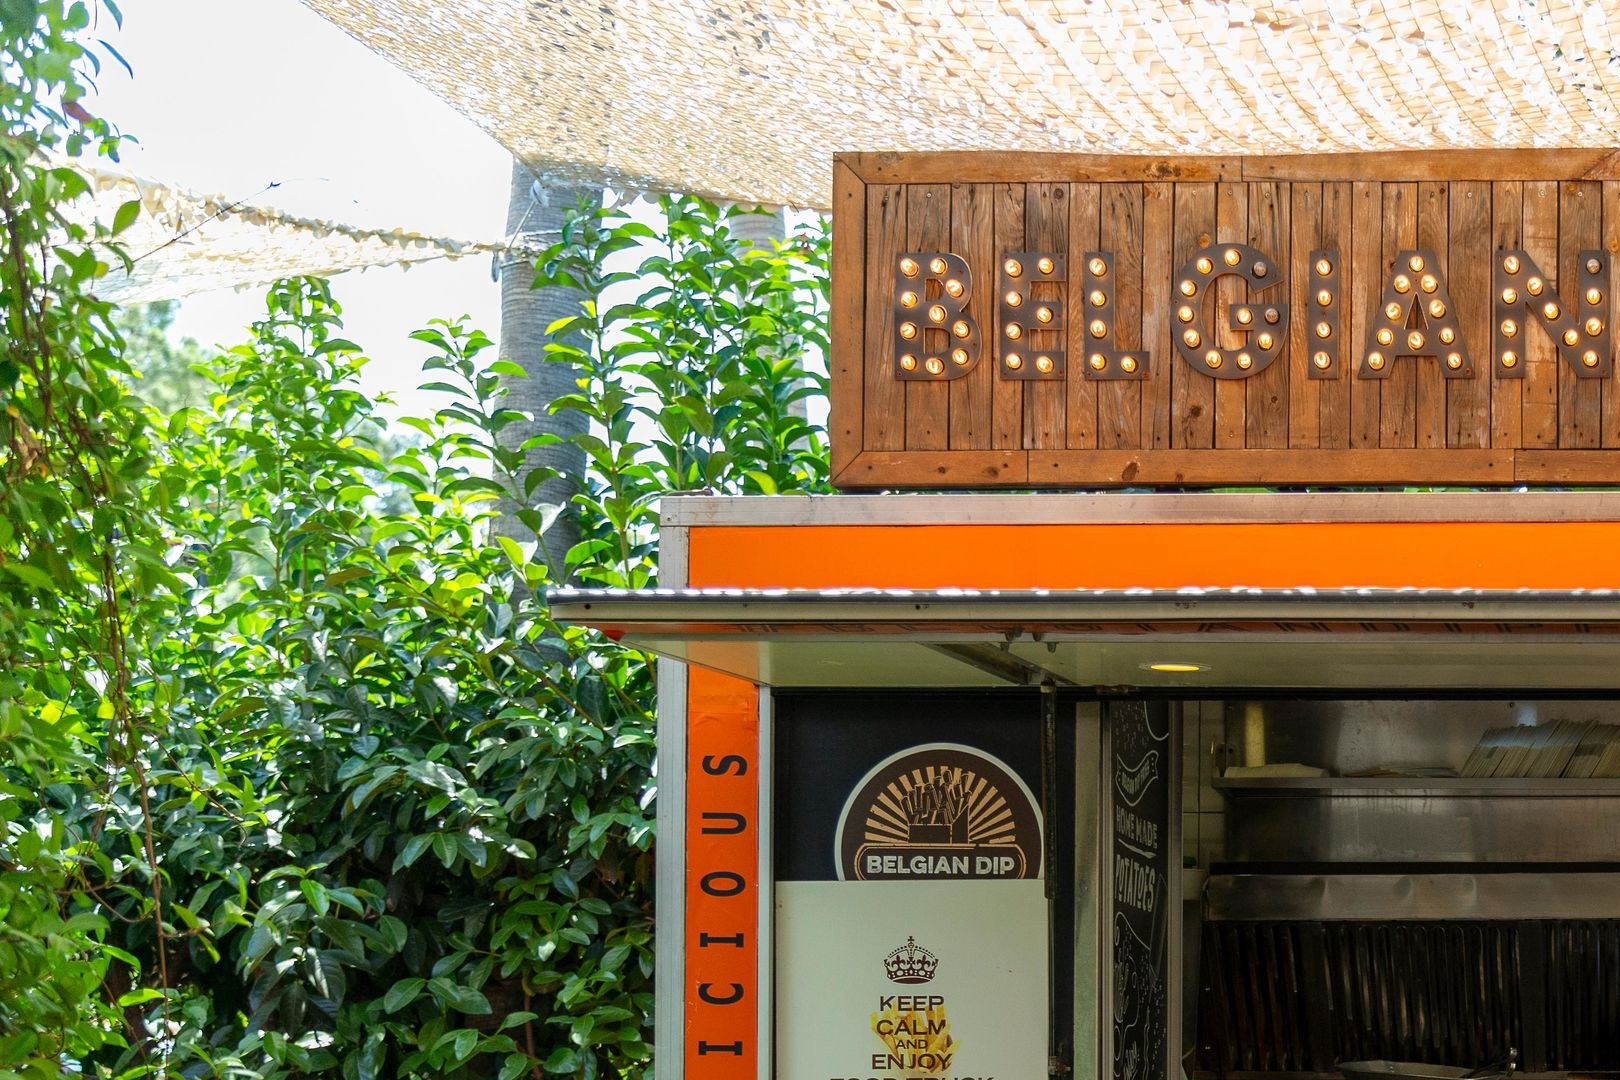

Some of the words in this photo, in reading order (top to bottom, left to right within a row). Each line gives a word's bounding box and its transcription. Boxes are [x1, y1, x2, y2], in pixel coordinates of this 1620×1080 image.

[894, 243, 1611, 380] BELGIAN
[1117, 804, 1135, 840] HOME
[1135, 815, 1158, 849] MADE
[866, 854, 970, 875] BELGIAN
[975, 855, 1015, 875] DIP
[1115, 854, 1156, 913] POTATOES
[879, 995, 945, 1012] KEEP
[876, 1019, 946, 1036] CALM
[895, 1039, 928, 1050] AND
[871, 1053, 953, 1072] ENJOY
